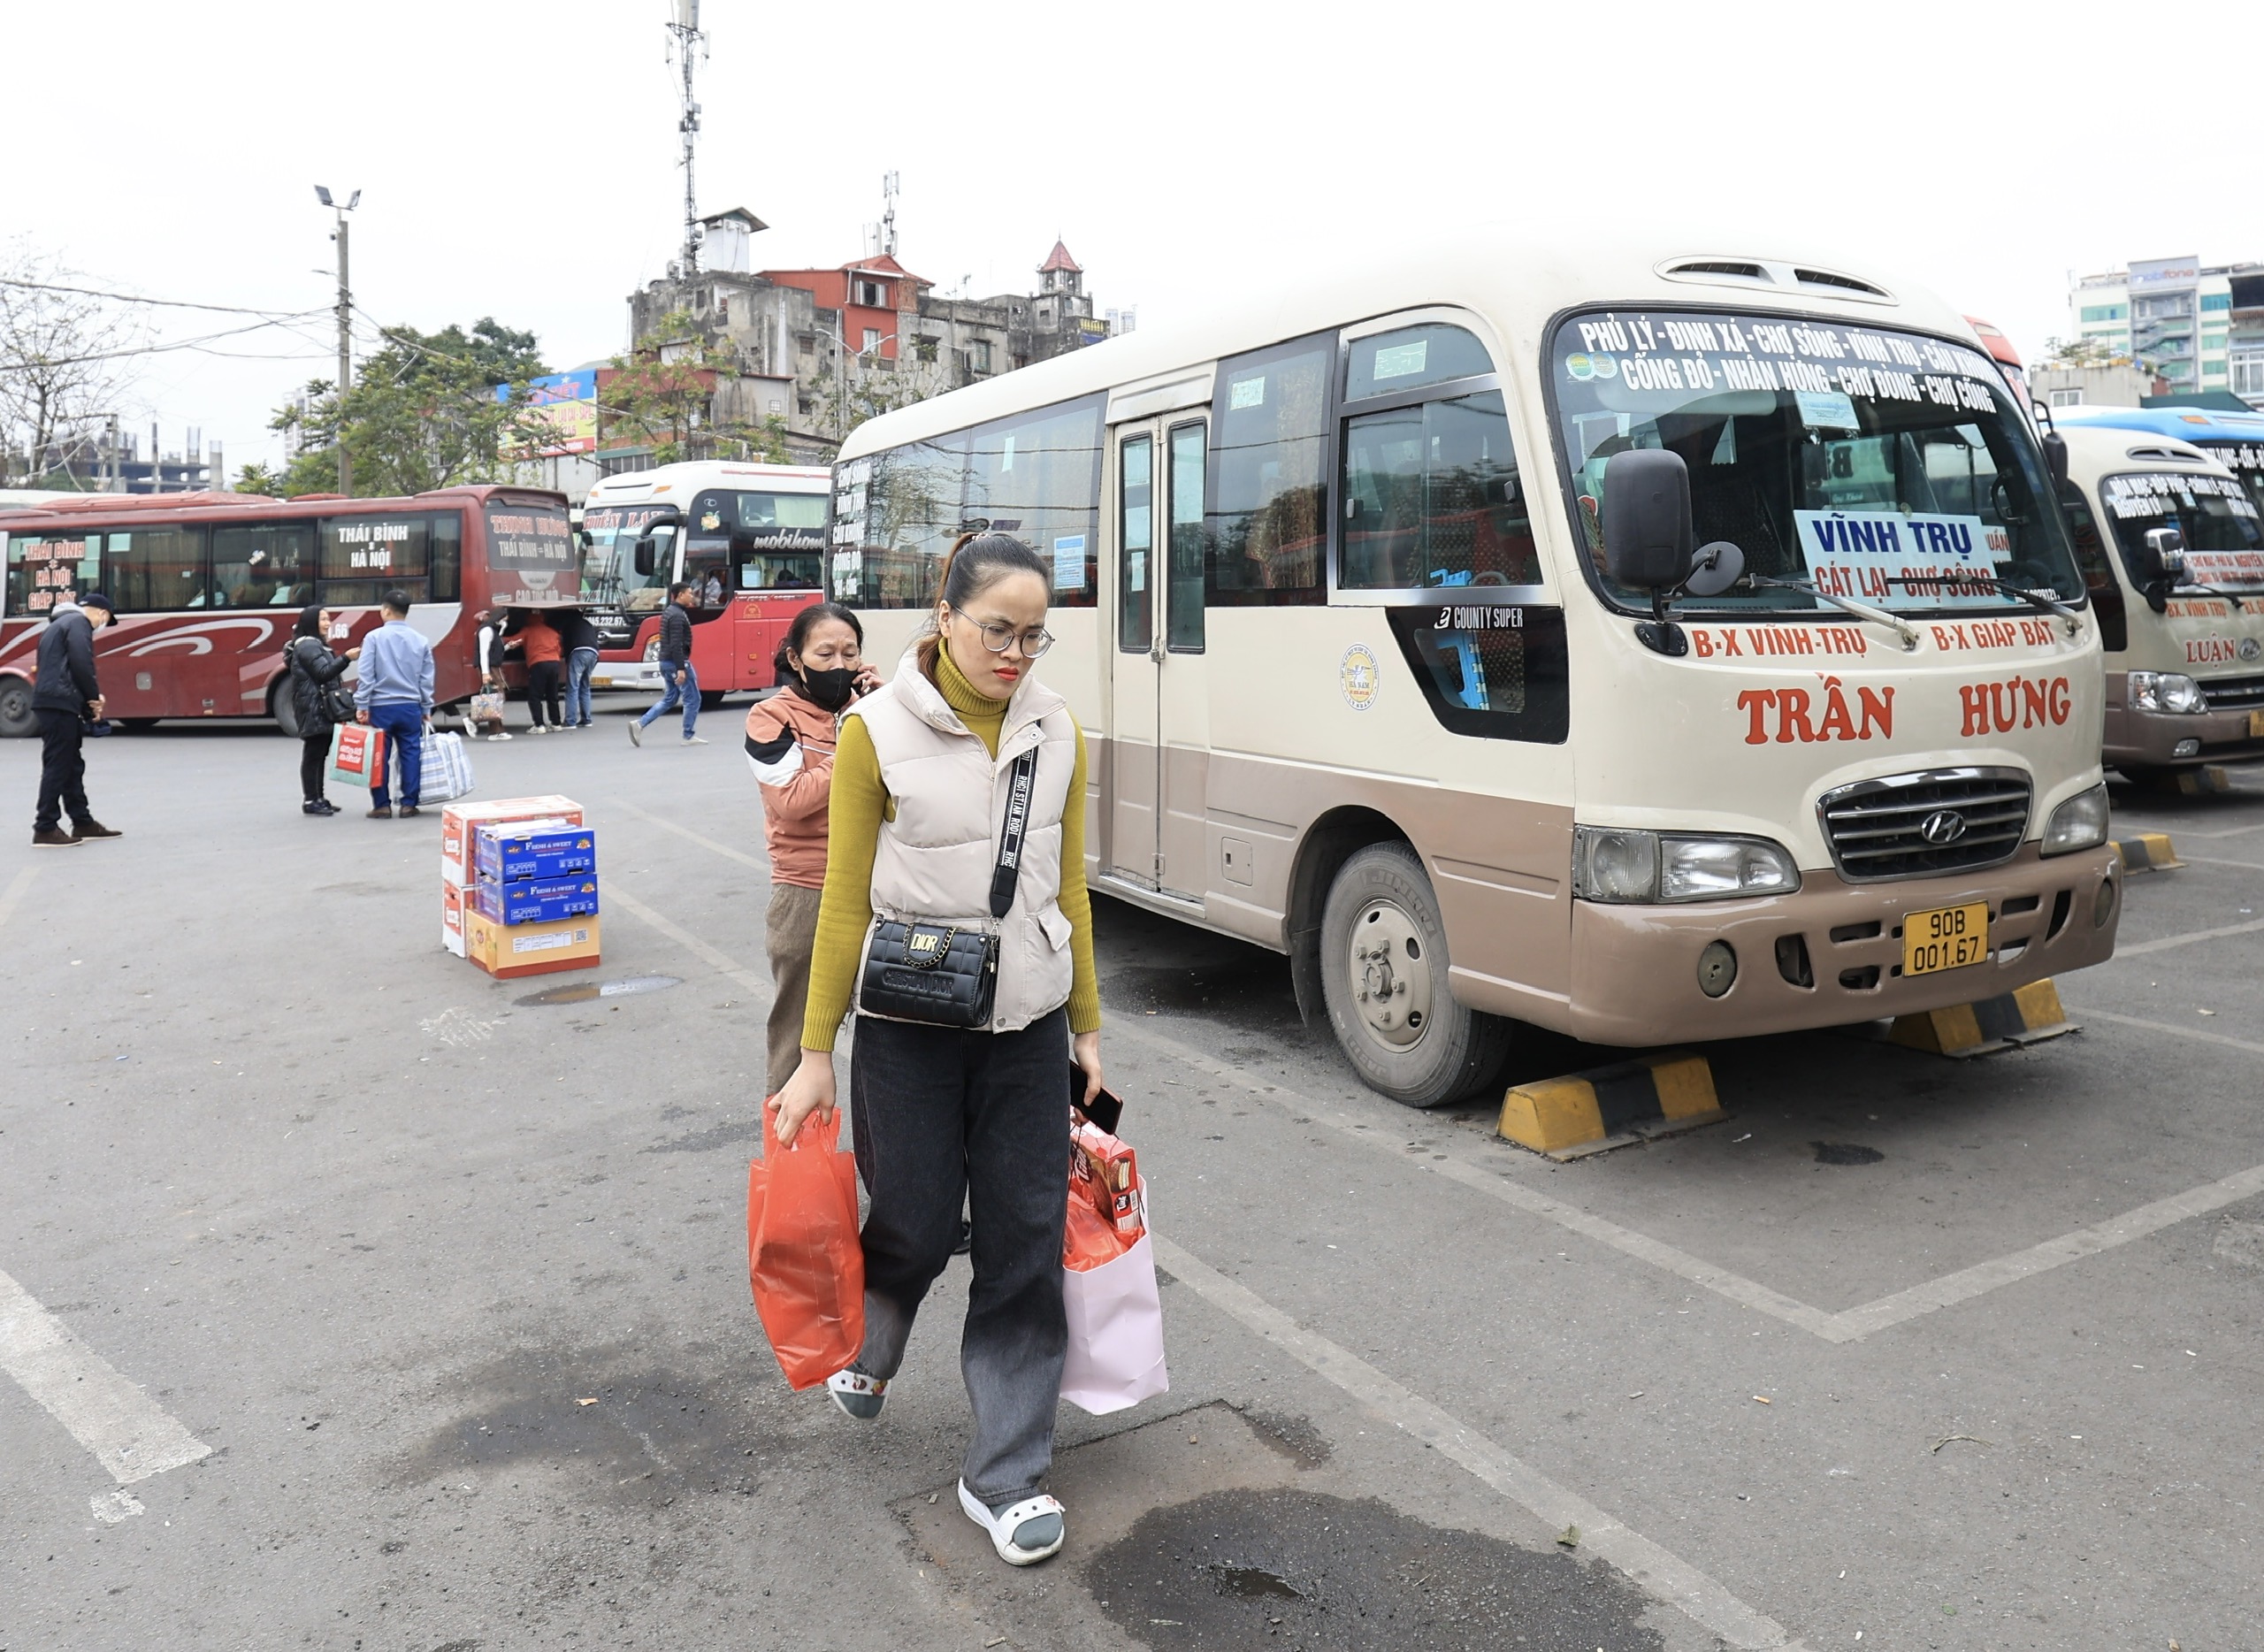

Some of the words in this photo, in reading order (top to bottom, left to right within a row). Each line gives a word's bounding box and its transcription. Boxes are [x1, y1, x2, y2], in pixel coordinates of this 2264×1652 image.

[1579, 312, 1629, 352] PHỦ
[1620, 351, 1684, 391] CỐNG
[338, 523, 370, 543] THÁI
[373, 522, 409, 542] BÌNH
[1811, 512, 1901, 554] VĨNH
[1907, 522, 1972, 561] TRỤ
[25, 539, 52, 562] THÁI
[54, 539, 85, 559] BÌNH
[350, 549, 368, 568] HÀ
[370, 547, 391, 570] NỘI
[498, 538, 518, 557] THÁI
[35, 567, 50, 587] HÀ
[51, 566, 71, 590] NỘI
[1815, 560, 1855, 598] CÁT
[1856, 567, 1891, 604] LẠI
[1901, 565, 1941, 604] CHỢ
[27, 588, 53, 610] GIÁP
[1454, 607, 1492, 630] COUNTY
[1493, 608, 1524, 628] SUPER
[1970, 619, 2017, 648] GIÁP
[2019, 616, 2056, 646] BÁT
[2185, 631, 2235, 668] LUẬN
[1737, 671, 1895, 746] TRẦN
[1958, 675, 2071, 738] HƯNG
[1930, 909, 1965, 938] 90B
[910, 933, 938, 952] DIOR
[1914, 936, 1979, 971] 001.67
